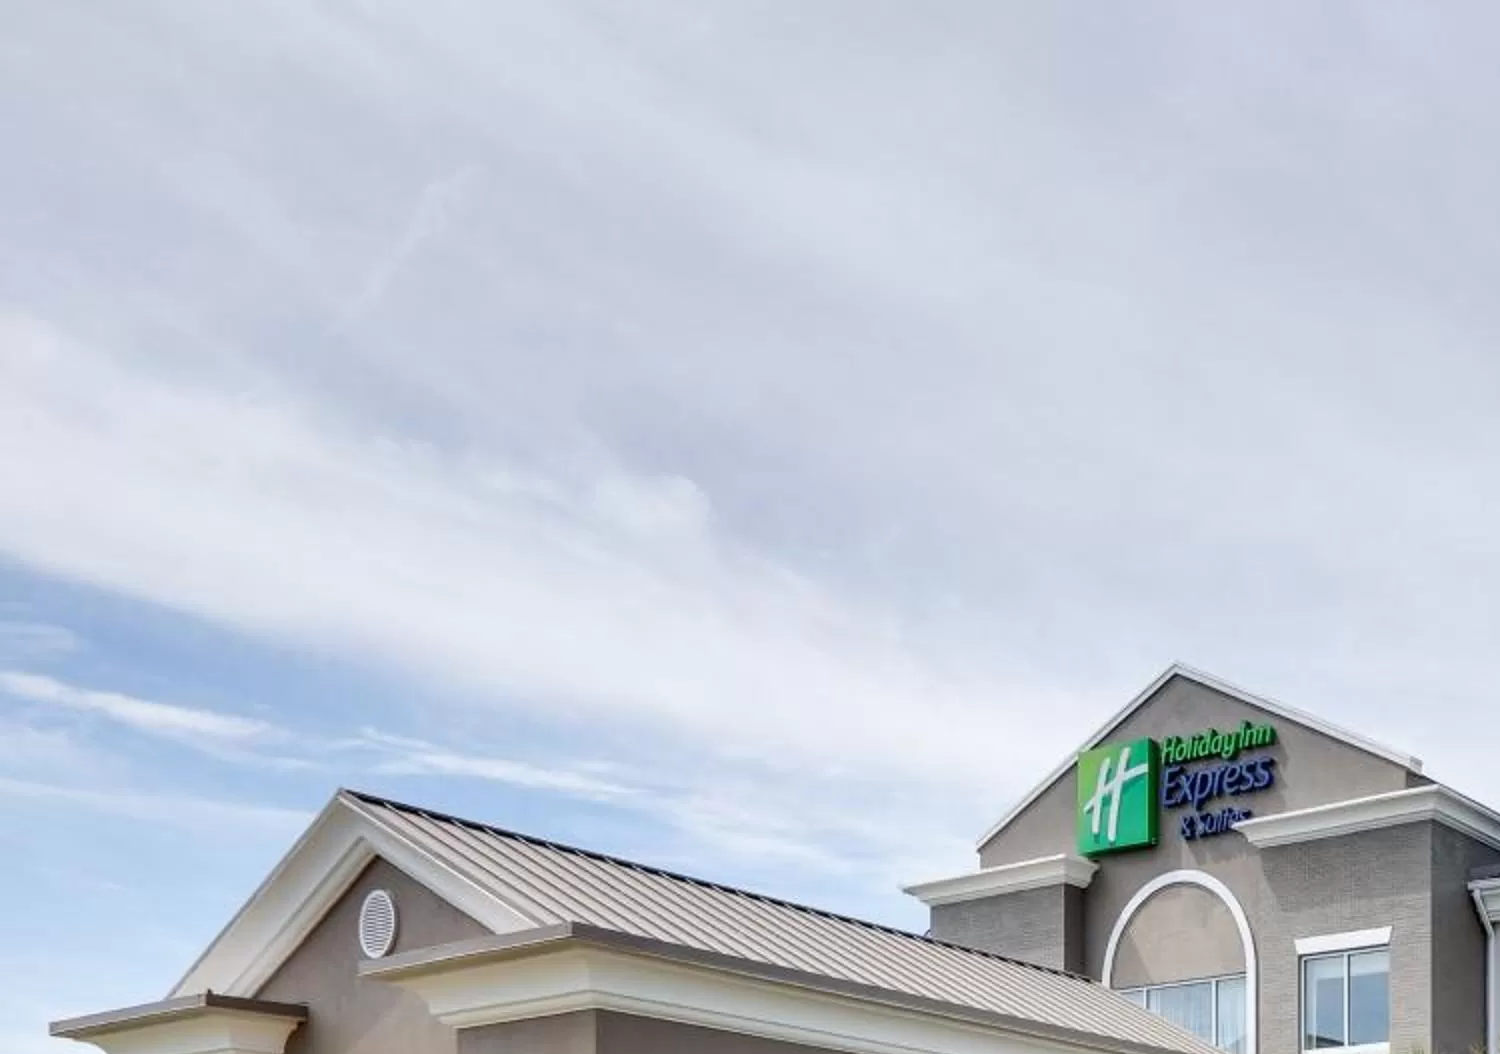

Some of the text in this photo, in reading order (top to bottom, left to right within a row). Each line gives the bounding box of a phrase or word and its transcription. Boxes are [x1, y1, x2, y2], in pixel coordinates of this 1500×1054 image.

[1161, 721, 1274, 764] Holiday Inn
[1161, 756, 1274, 809] Express
[1180, 814, 1195, 838] &
